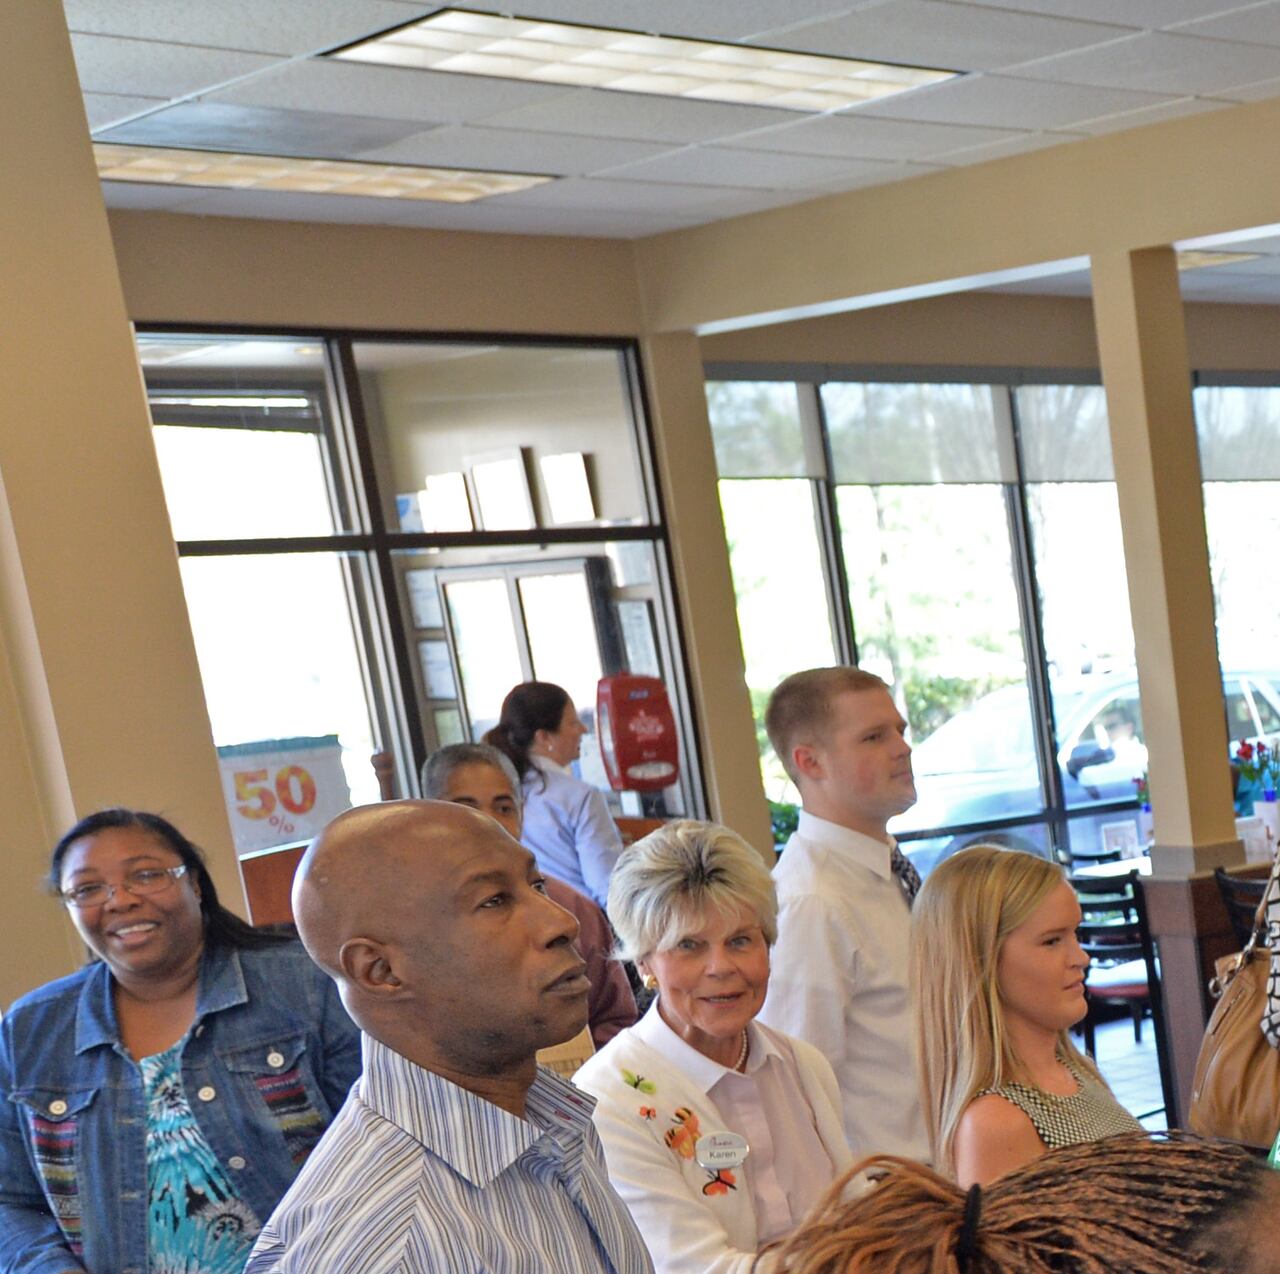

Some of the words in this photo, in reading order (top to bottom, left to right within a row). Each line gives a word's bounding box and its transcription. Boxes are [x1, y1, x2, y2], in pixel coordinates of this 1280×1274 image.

[234, 765, 317, 820] 50
[268, 815, 295, 834] %
[709, 1150, 737, 1160] Karen
